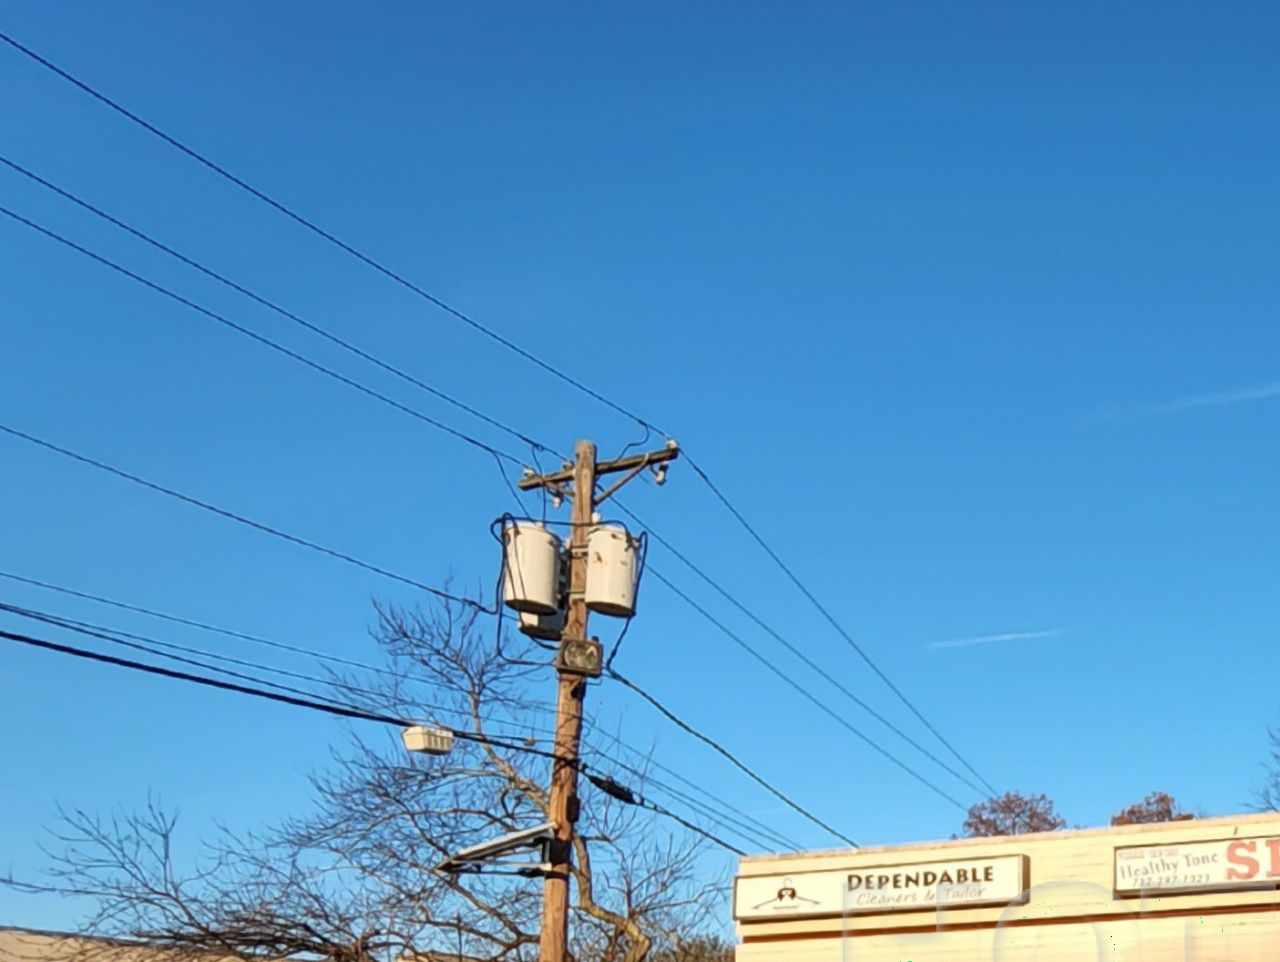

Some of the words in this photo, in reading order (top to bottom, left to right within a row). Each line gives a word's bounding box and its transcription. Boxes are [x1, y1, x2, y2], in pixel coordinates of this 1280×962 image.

[847, 866, 994, 892] DEPENDABLE
[1120, 857, 1177, 880] Healthy
[1183, 852, 1219, 867] Tone
[856, 890, 917, 906] Cleaners
[923, 890, 936, 901] &
[945, 886, 985, 900] Tailor
